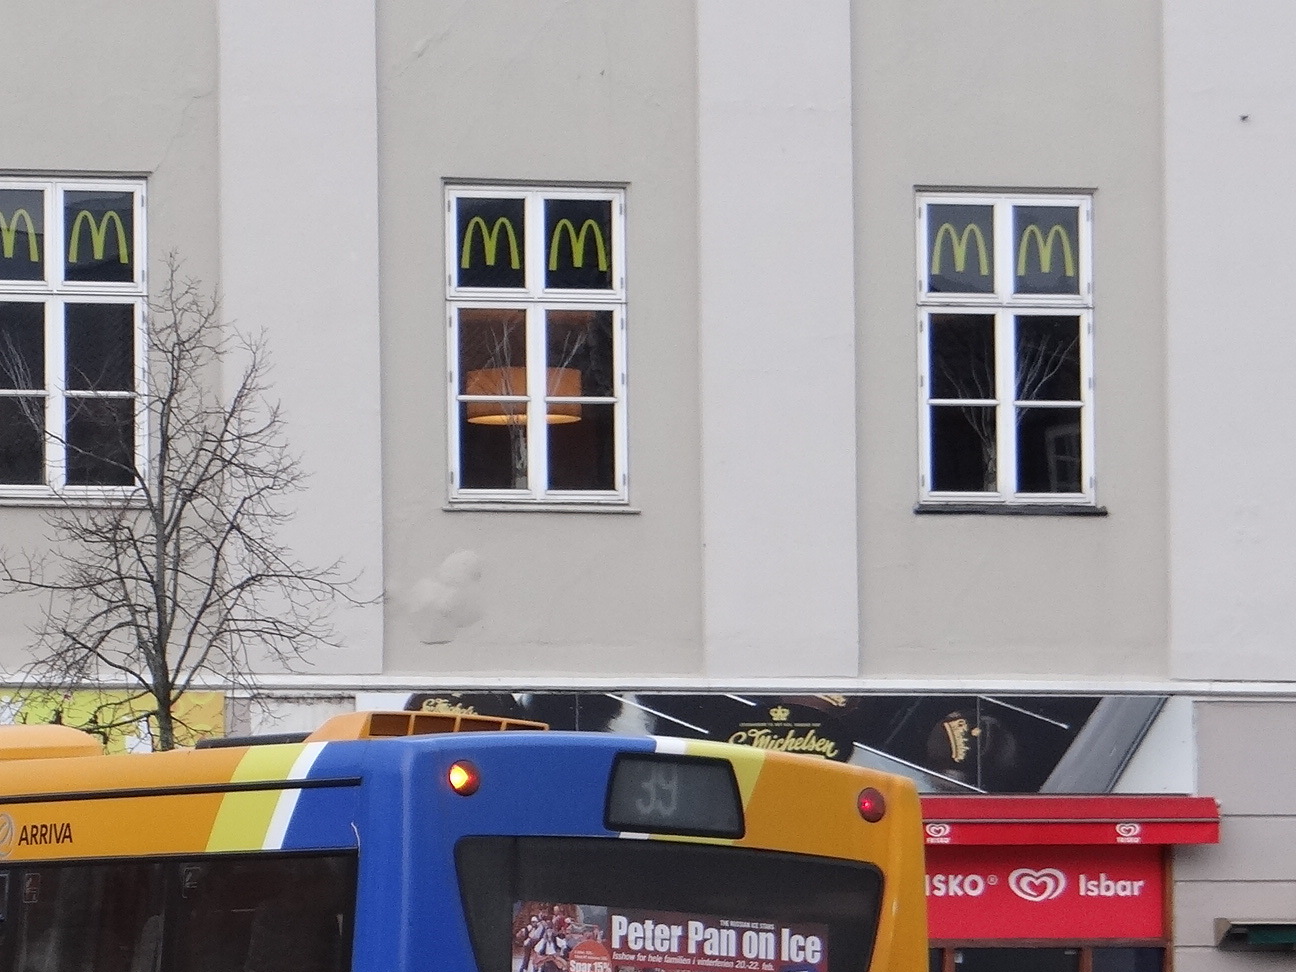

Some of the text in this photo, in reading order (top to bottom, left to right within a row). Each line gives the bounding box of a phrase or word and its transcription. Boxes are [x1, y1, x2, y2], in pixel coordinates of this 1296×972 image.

[18, 822, 73, 846] ARRIVA
[1078, 872, 1145, 897] Isbar
[611, 914, 822, 963] Peter Pan on Ice
[569, 959, 592, 972] Spar
